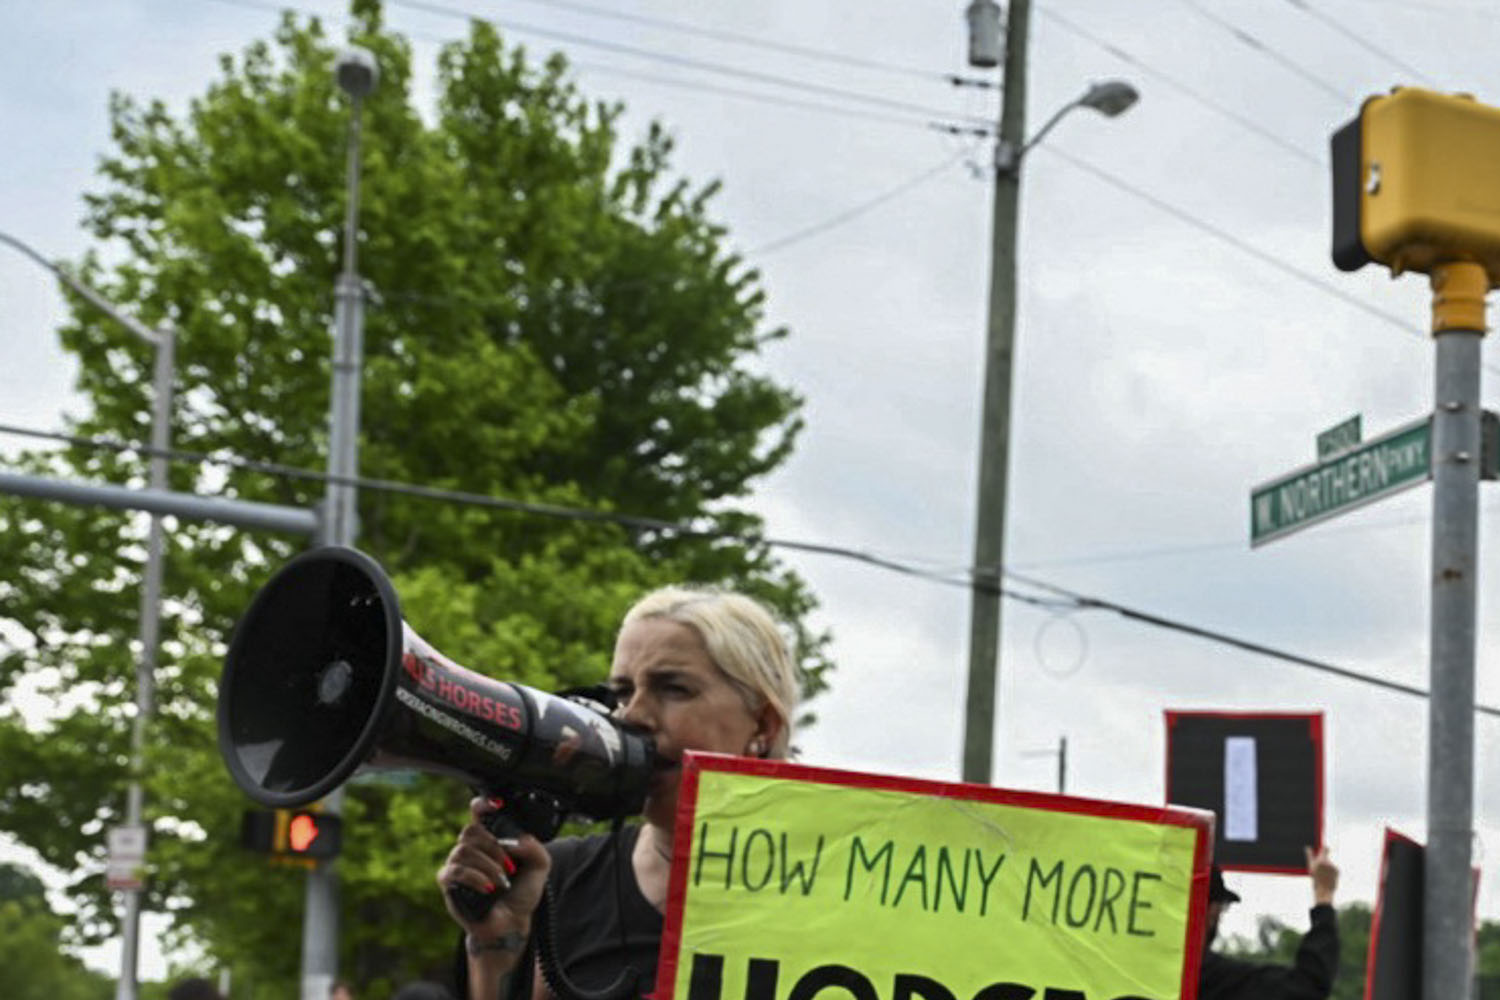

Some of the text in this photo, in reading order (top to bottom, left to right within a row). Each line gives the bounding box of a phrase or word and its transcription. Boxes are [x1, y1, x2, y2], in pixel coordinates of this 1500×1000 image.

[1279, 447, 1388, 523] NORTHERN
[439, 675, 522, 731] HORSES
[694, 822, 1162, 937] HOW MANY MORE
